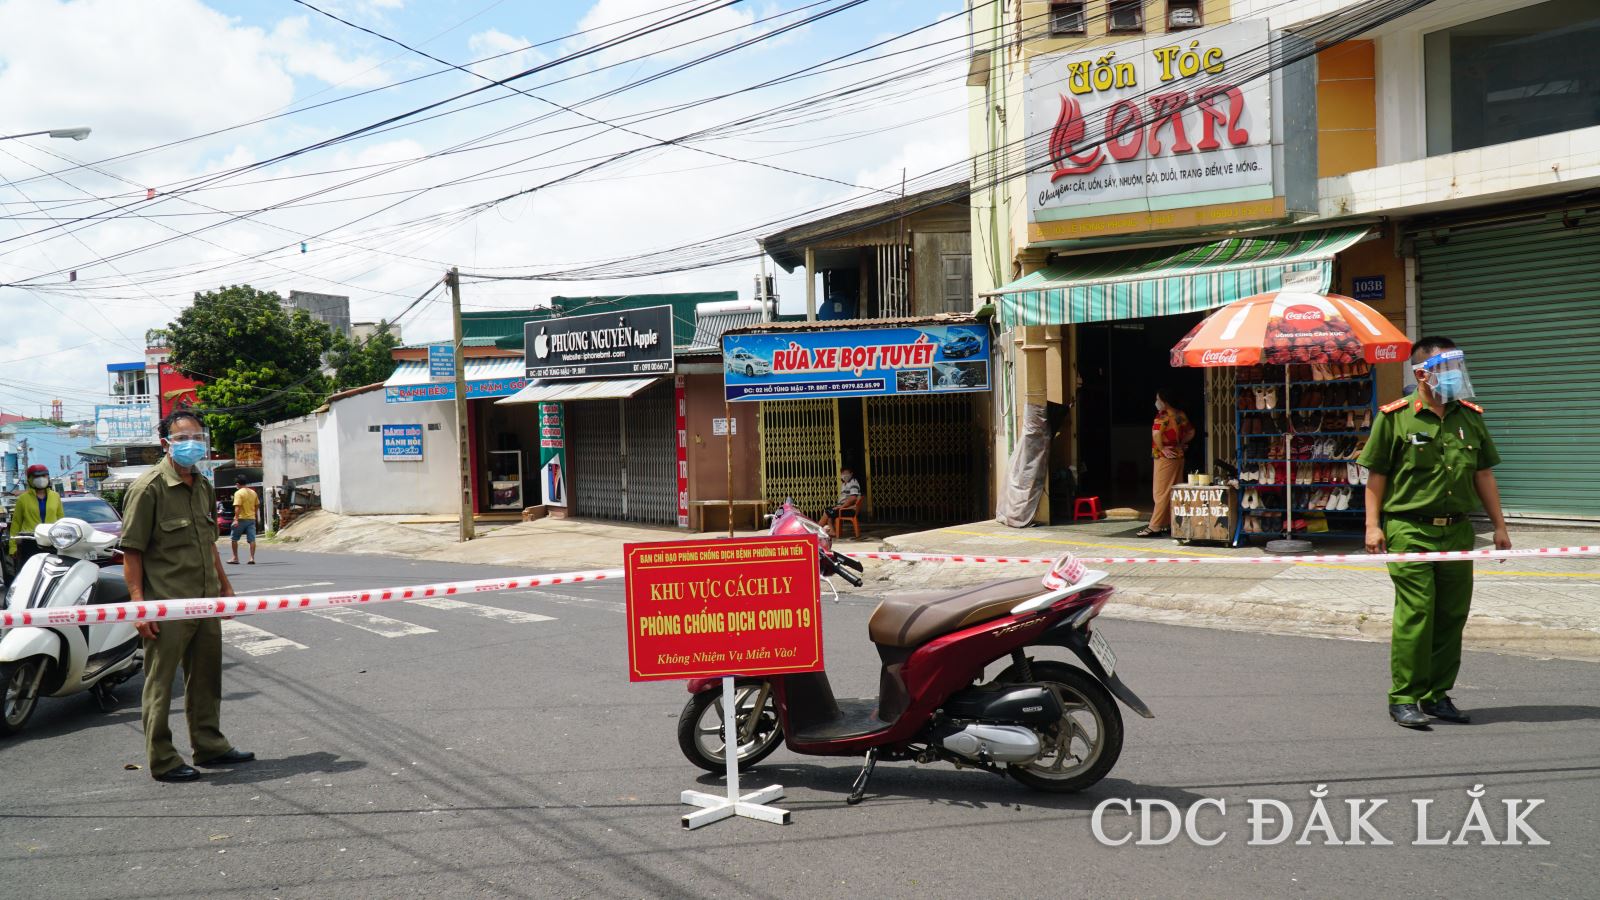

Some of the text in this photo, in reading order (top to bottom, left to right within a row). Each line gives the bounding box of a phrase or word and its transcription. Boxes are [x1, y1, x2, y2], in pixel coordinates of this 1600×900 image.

[1153, 40, 1226, 81] Tóc
[1180, 168, 1202, 179] TRANG
[1354, 280, 1383, 292] 103B
[551, 330, 588, 353] PHƯƠNG
[634, 329, 658, 349] Apple
[773, 333, 935, 376] RỬA XE BỌT TUYẾT
[399, 386, 426, 397] BÁNH
[385, 437, 406, 446] BÁNH
[640, 544, 803, 564] BAN CHỈ ĐẠO PHÒNG CHỐNG DỊCH BỆNH PHƯỜNG TÂN TIẾN
[650, 574, 793, 603] KHU VỰC CÁCH LY
[639, 606, 811, 637] PHÒNG CHỐNG DỊCH COVID 19
[657, 646, 797, 665] Không Nhiệm Vụ Miễn Vào!
